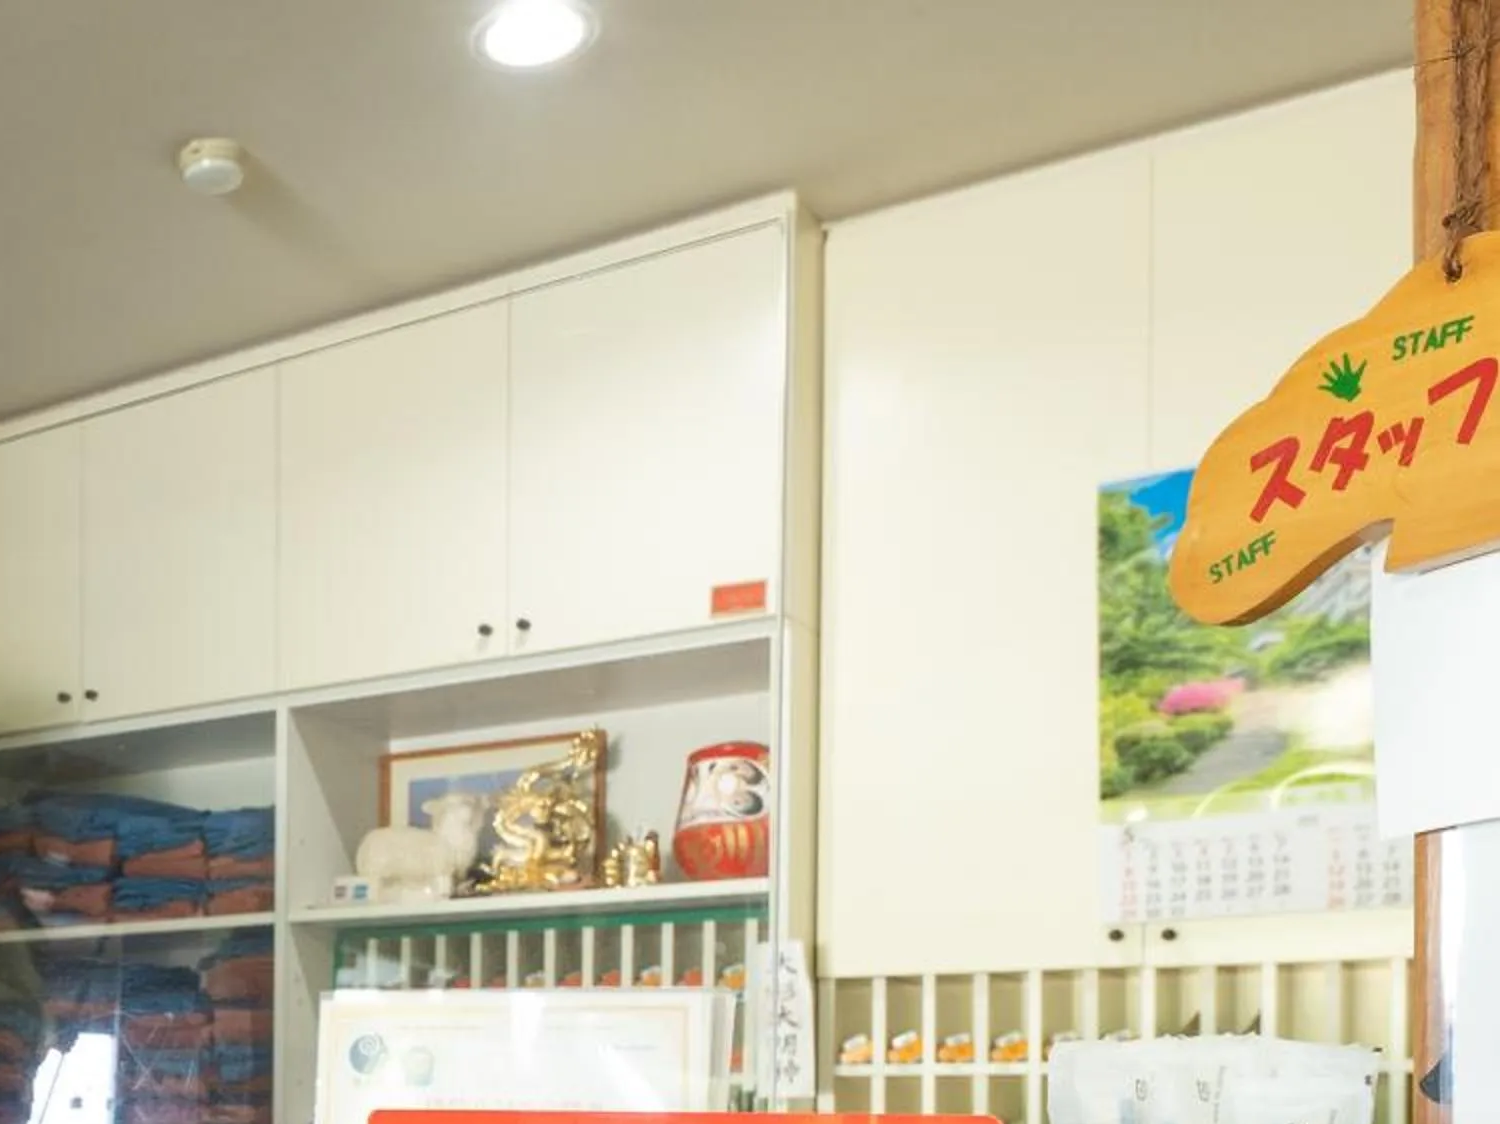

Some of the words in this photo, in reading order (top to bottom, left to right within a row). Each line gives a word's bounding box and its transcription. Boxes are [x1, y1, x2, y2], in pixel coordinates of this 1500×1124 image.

[1392, 315, 1476, 361] STAFF
[1250, 357, 1499, 524] スタッフ
[1209, 530, 1277, 585] STAFF
